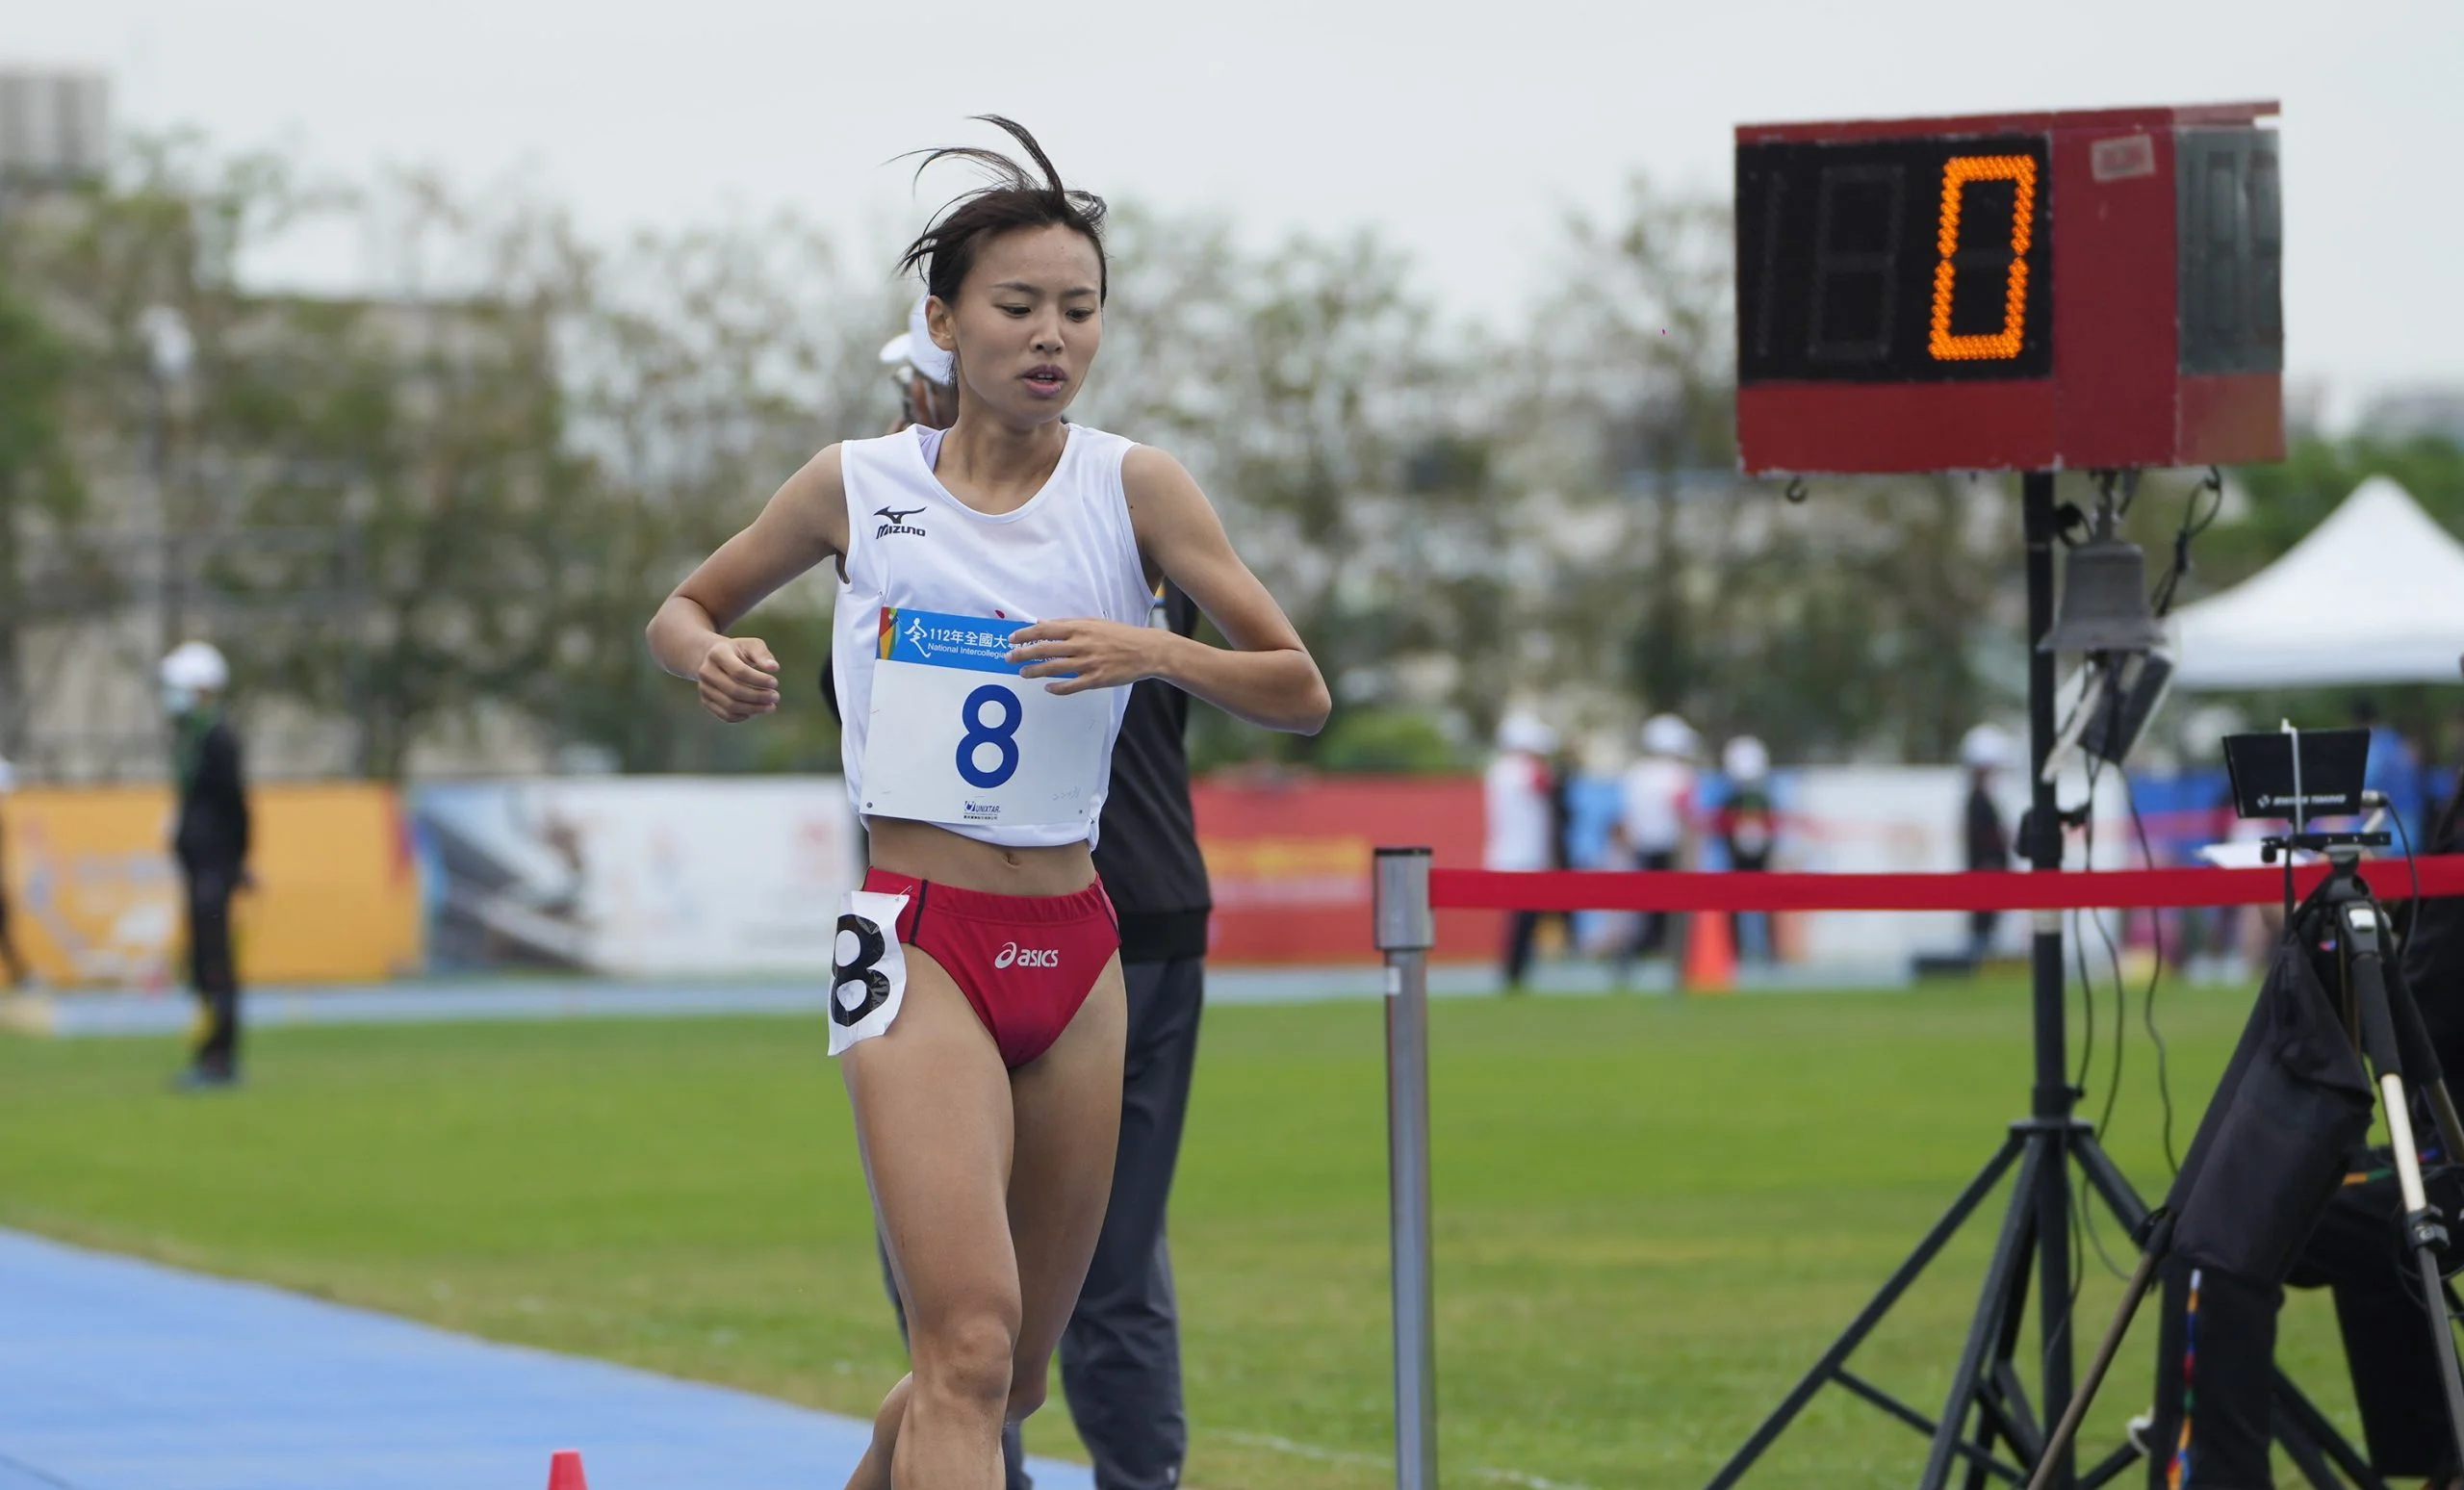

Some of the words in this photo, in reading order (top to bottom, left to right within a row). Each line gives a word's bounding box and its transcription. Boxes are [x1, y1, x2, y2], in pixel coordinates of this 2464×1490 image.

[1928, 154, 2037, 361] 0
[927, 643, 959, 655] National
[960, 648, 1008, 660] Intercollegia
[930, 628, 1033, 652] 112年全國大
[956, 683, 1023, 789] 8
[831, 913, 891, 1027] 8
[1016, 948, 1060, 968] asics
